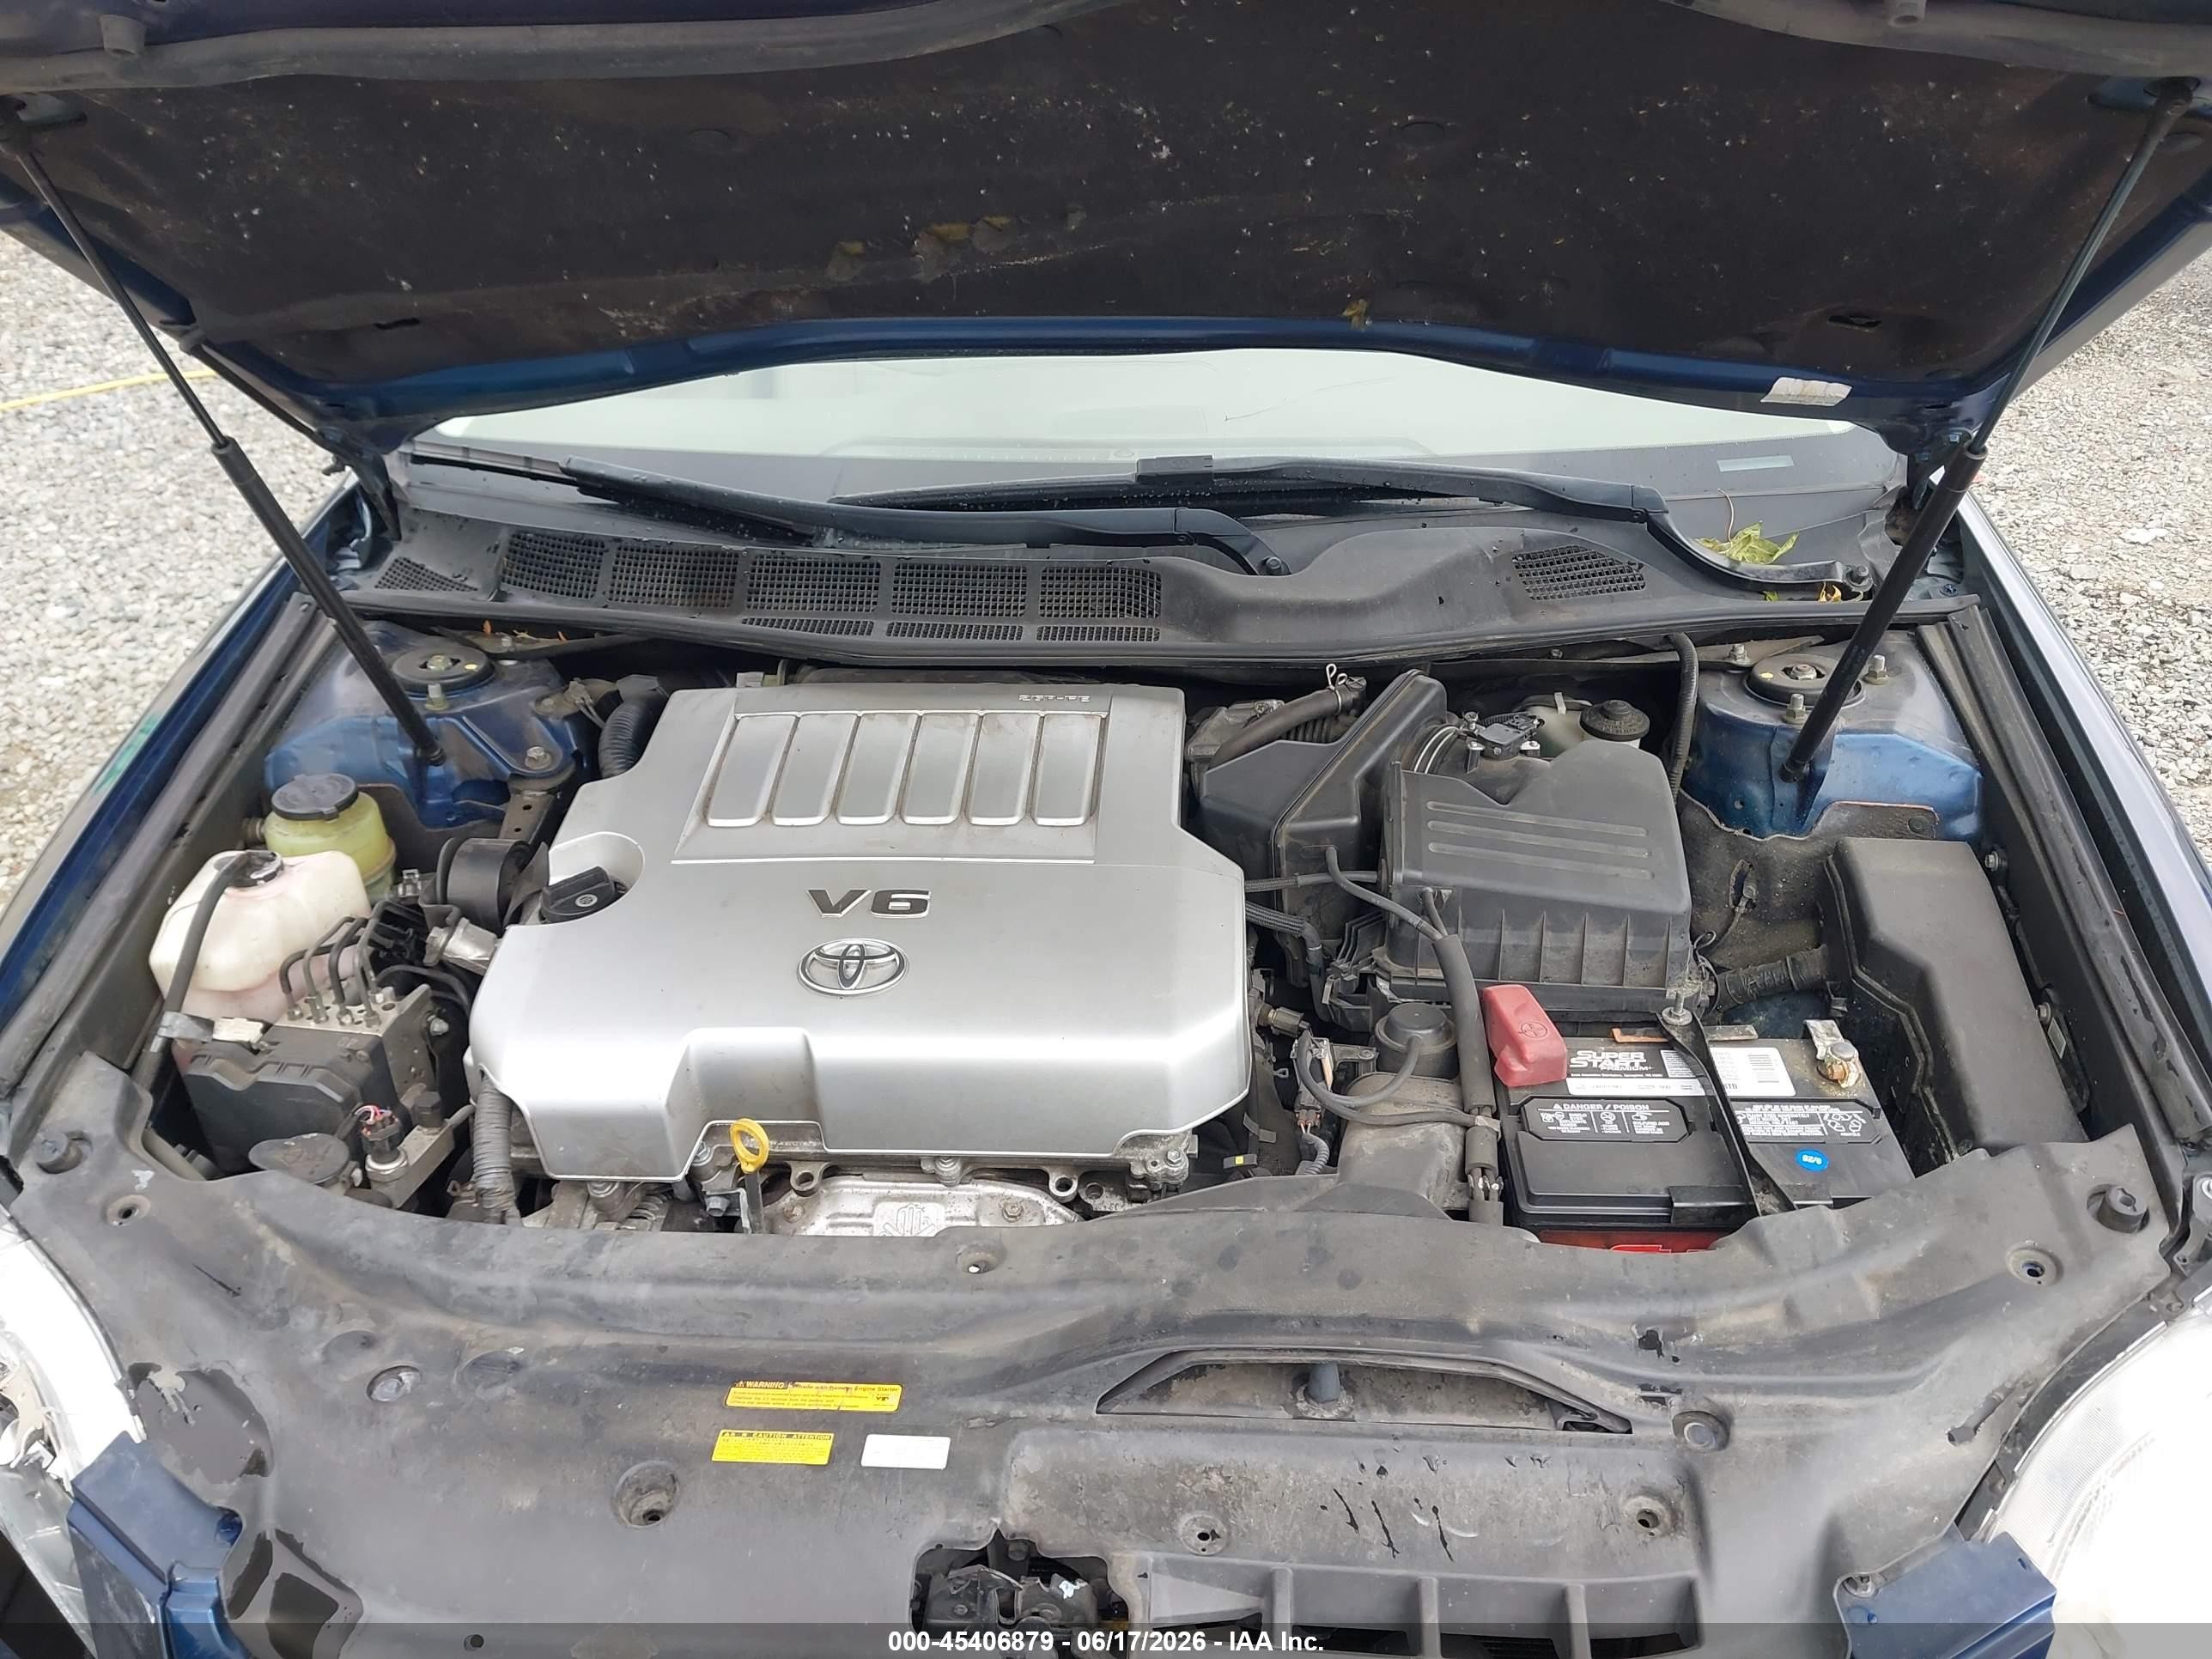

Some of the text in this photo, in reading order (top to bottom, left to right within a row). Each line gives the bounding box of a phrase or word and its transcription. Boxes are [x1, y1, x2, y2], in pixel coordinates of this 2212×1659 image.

[807, 889, 932, 918] V6
[1577, 1049, 1644, 1060] SUPER
[1570, 1057, 1647, 1068] START
[745, 1380, 785, 1389] WARNING
